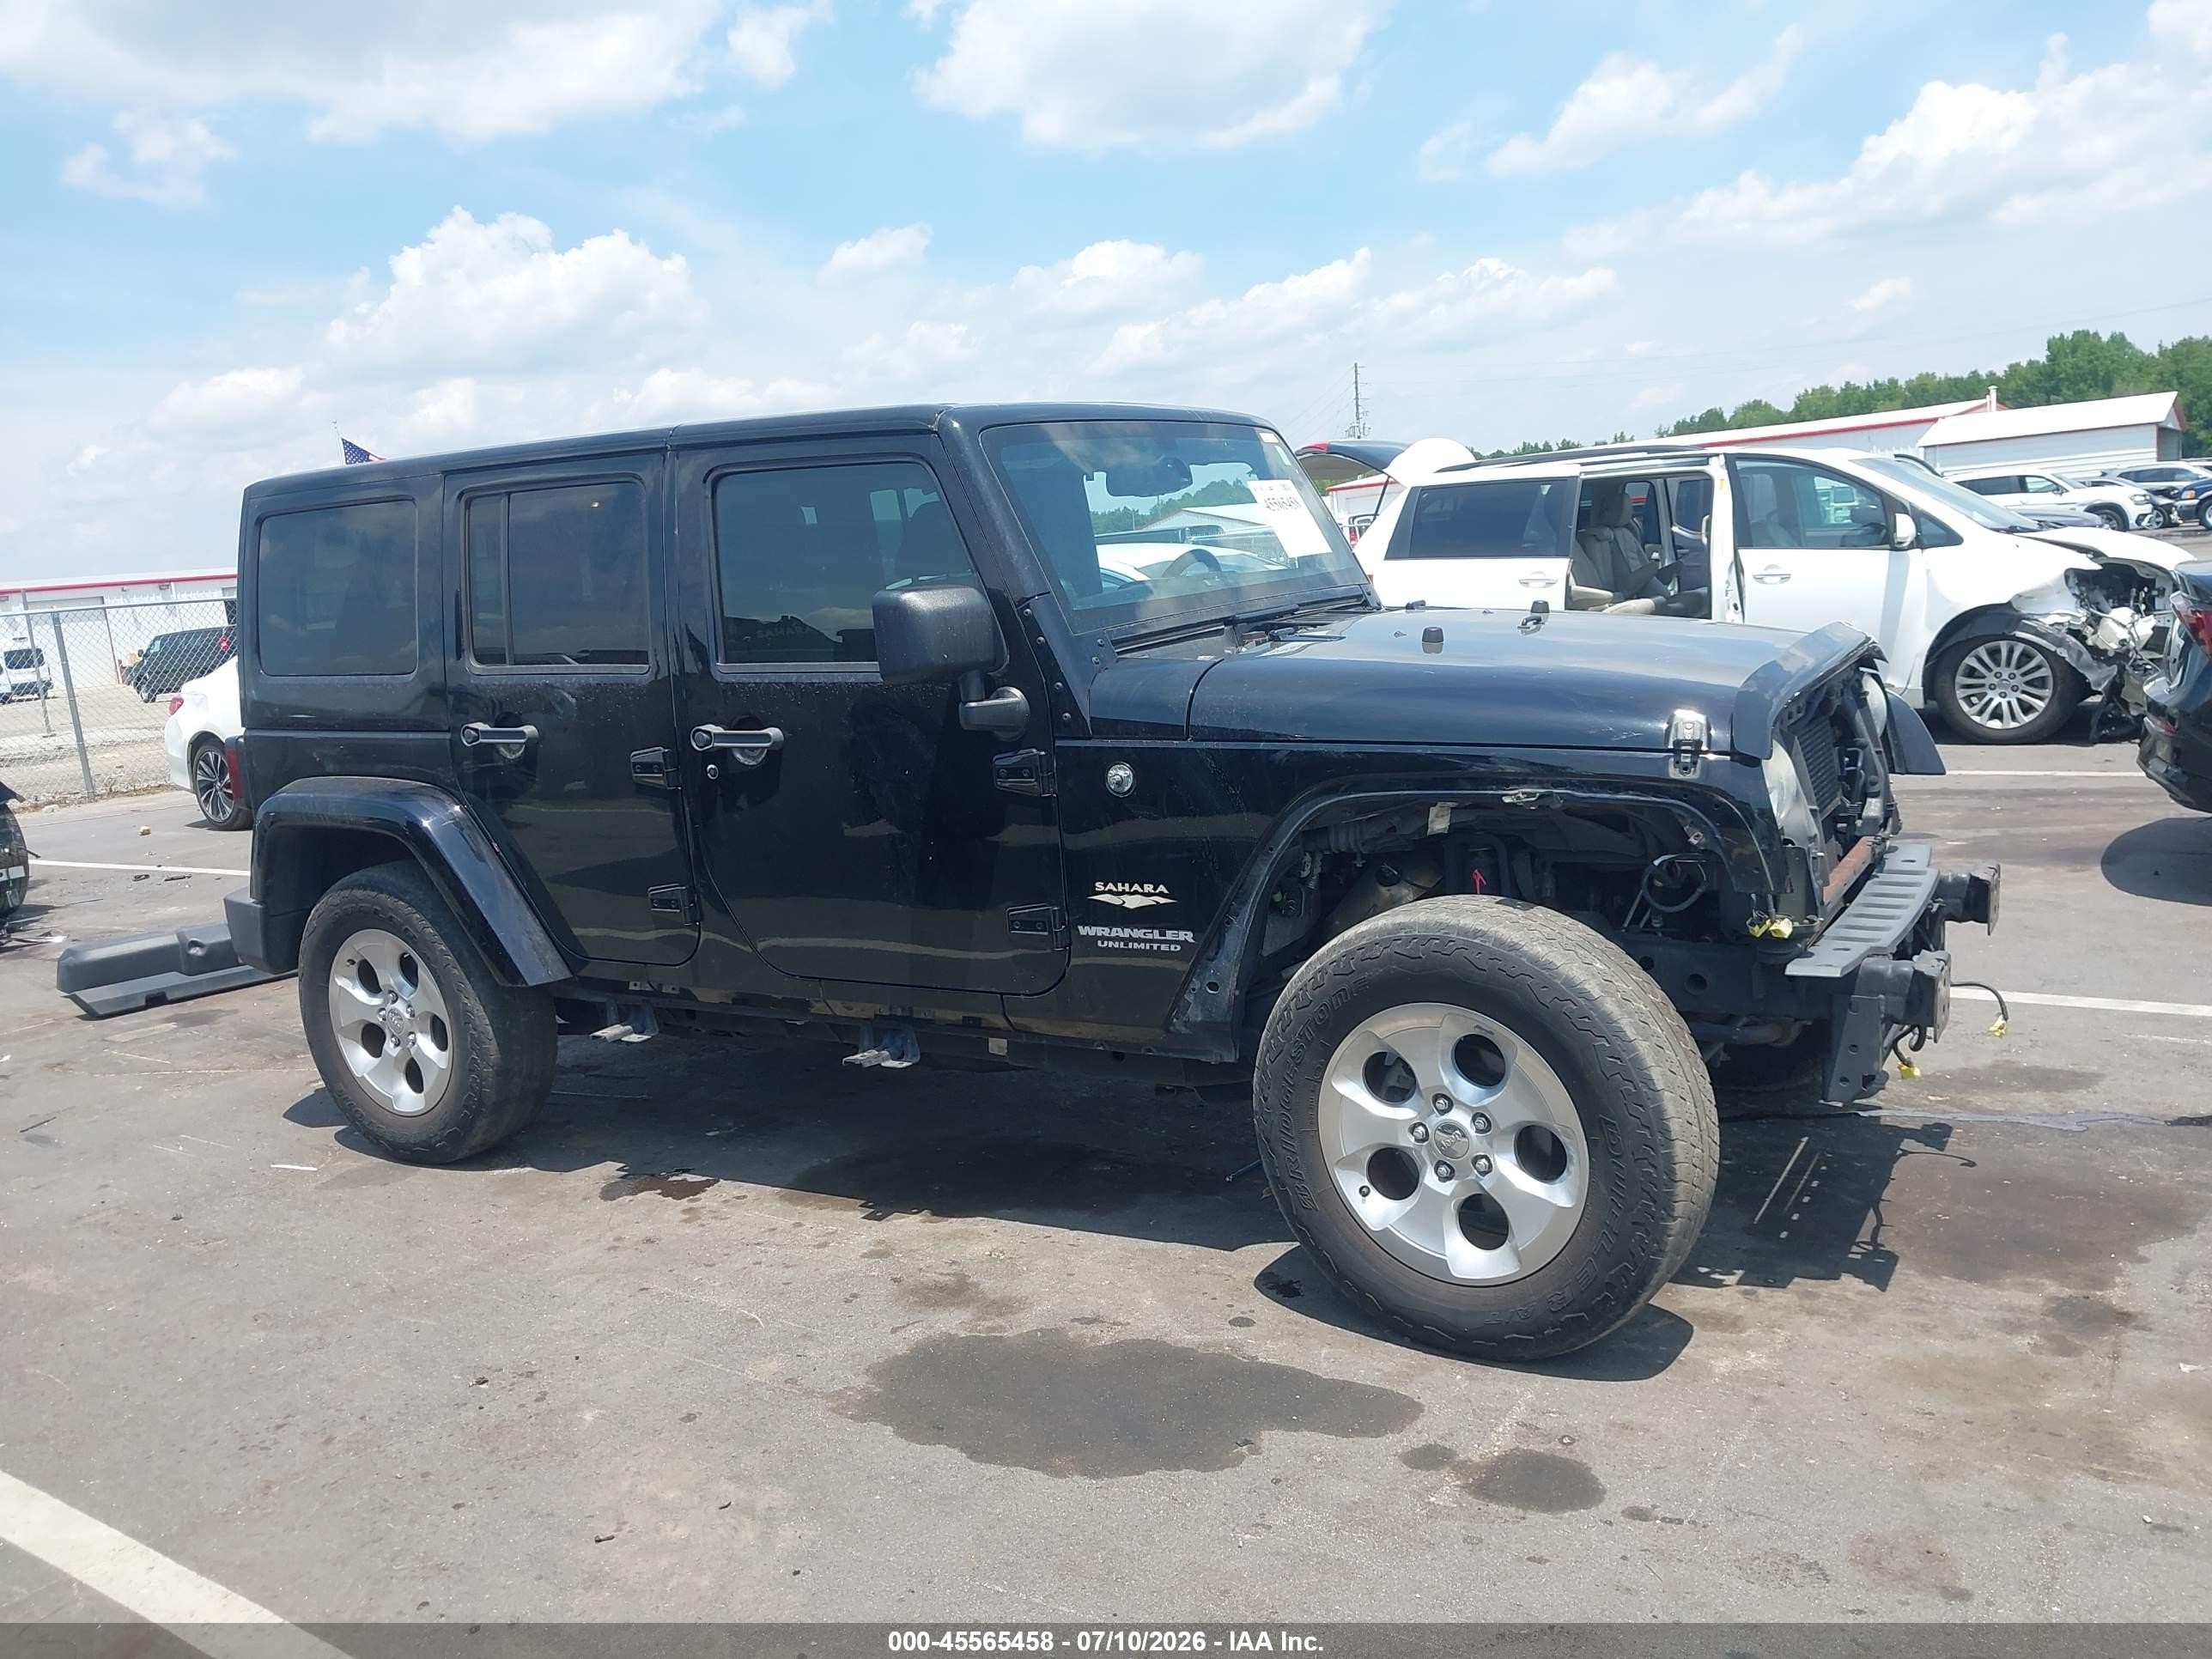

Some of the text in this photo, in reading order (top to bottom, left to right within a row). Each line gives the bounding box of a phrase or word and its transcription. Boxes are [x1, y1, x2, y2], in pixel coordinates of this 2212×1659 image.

[1095, 881, 1170, 894] SAHARA
[1077, 925, 1196, 943] WRANGLER
[1097, 939, 1182, 951] UNLIMITED
[1279, 975, 1370, 1211] BRIDGESTONE
